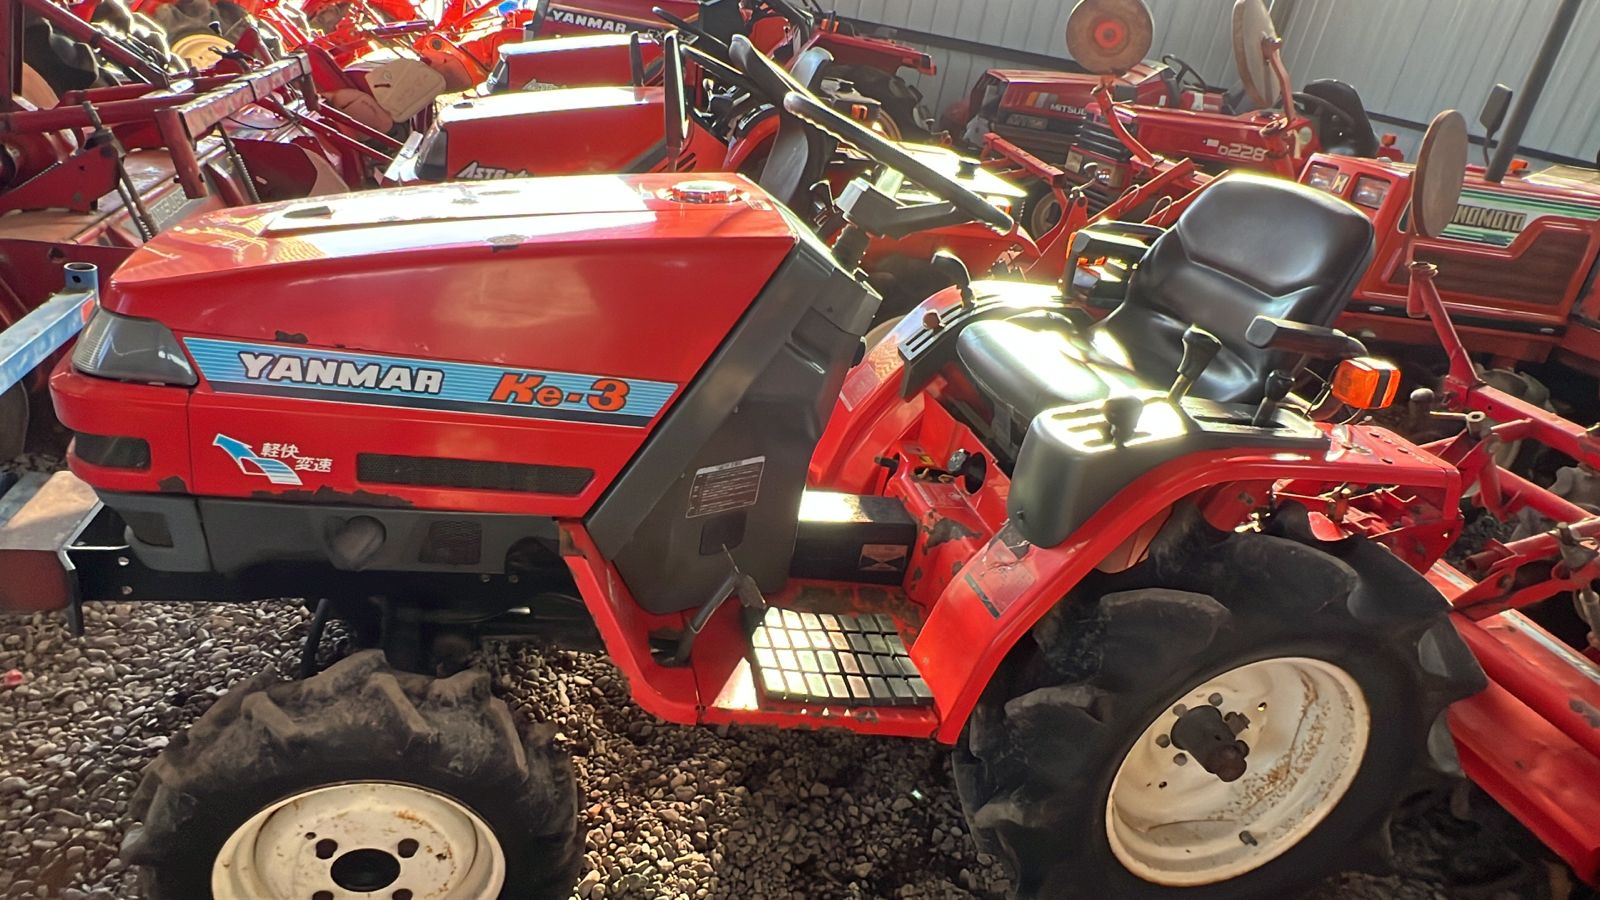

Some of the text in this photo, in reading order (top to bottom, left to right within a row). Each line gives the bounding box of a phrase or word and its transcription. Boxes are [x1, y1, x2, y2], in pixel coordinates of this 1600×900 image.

[552, 11, 627, 33] YANMAR
[1451, 204, 1527, 232] NOMOTO
[238, 352, 445, 395] YANMAR
[489, 372, 630, 412] Ke-3
[260, 442, 300, 459] 軽快
[294, 456, 333, 473] 変速
